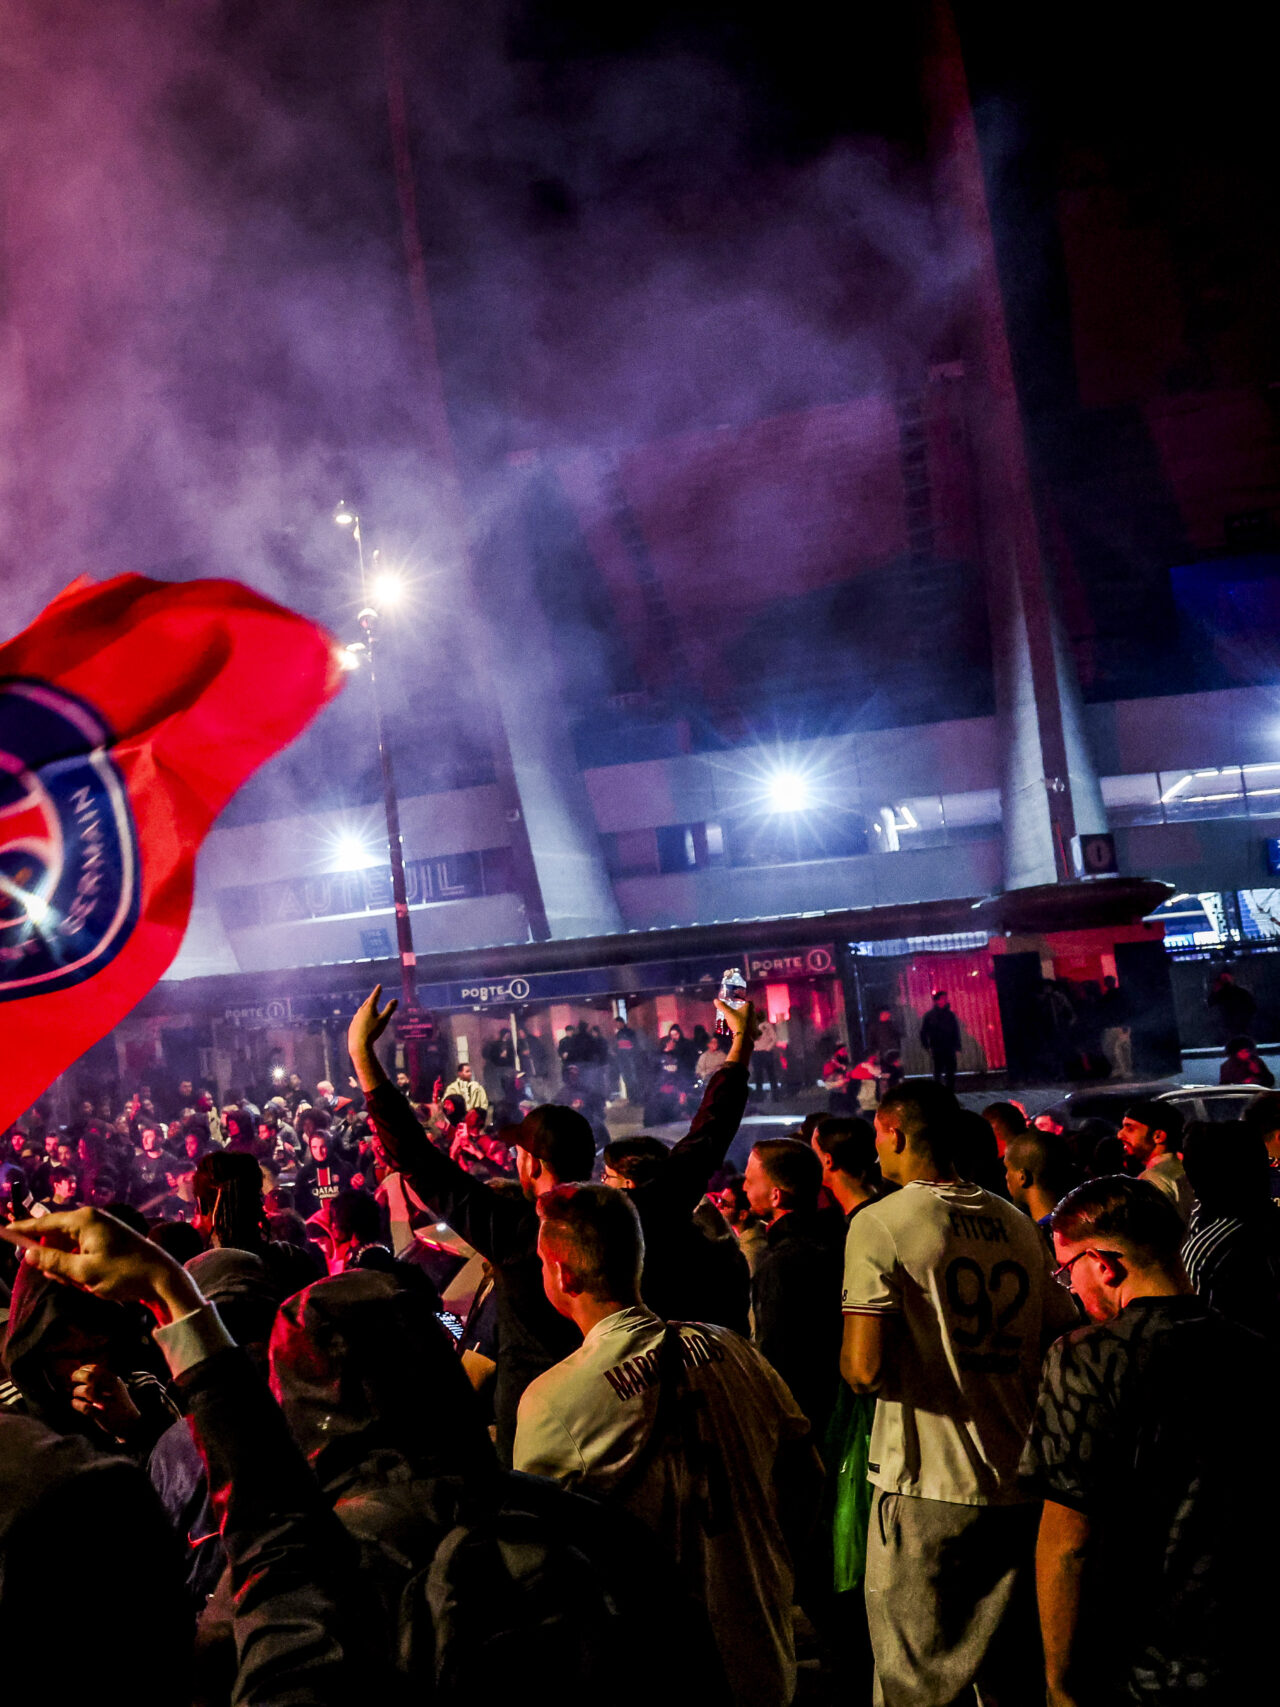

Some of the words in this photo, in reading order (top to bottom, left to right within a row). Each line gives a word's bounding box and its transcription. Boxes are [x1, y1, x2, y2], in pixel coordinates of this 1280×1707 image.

[752, 956, 802, 971] PORTE
[461, 985, 505, 999] PORTE
[224, 1007, 264, 1019] PORTE
[312, 1186, 340, 1197] QATAR
[948, 1211, 1010, 1243] FITCH
[946, 1257, 1029, 1347] 92
